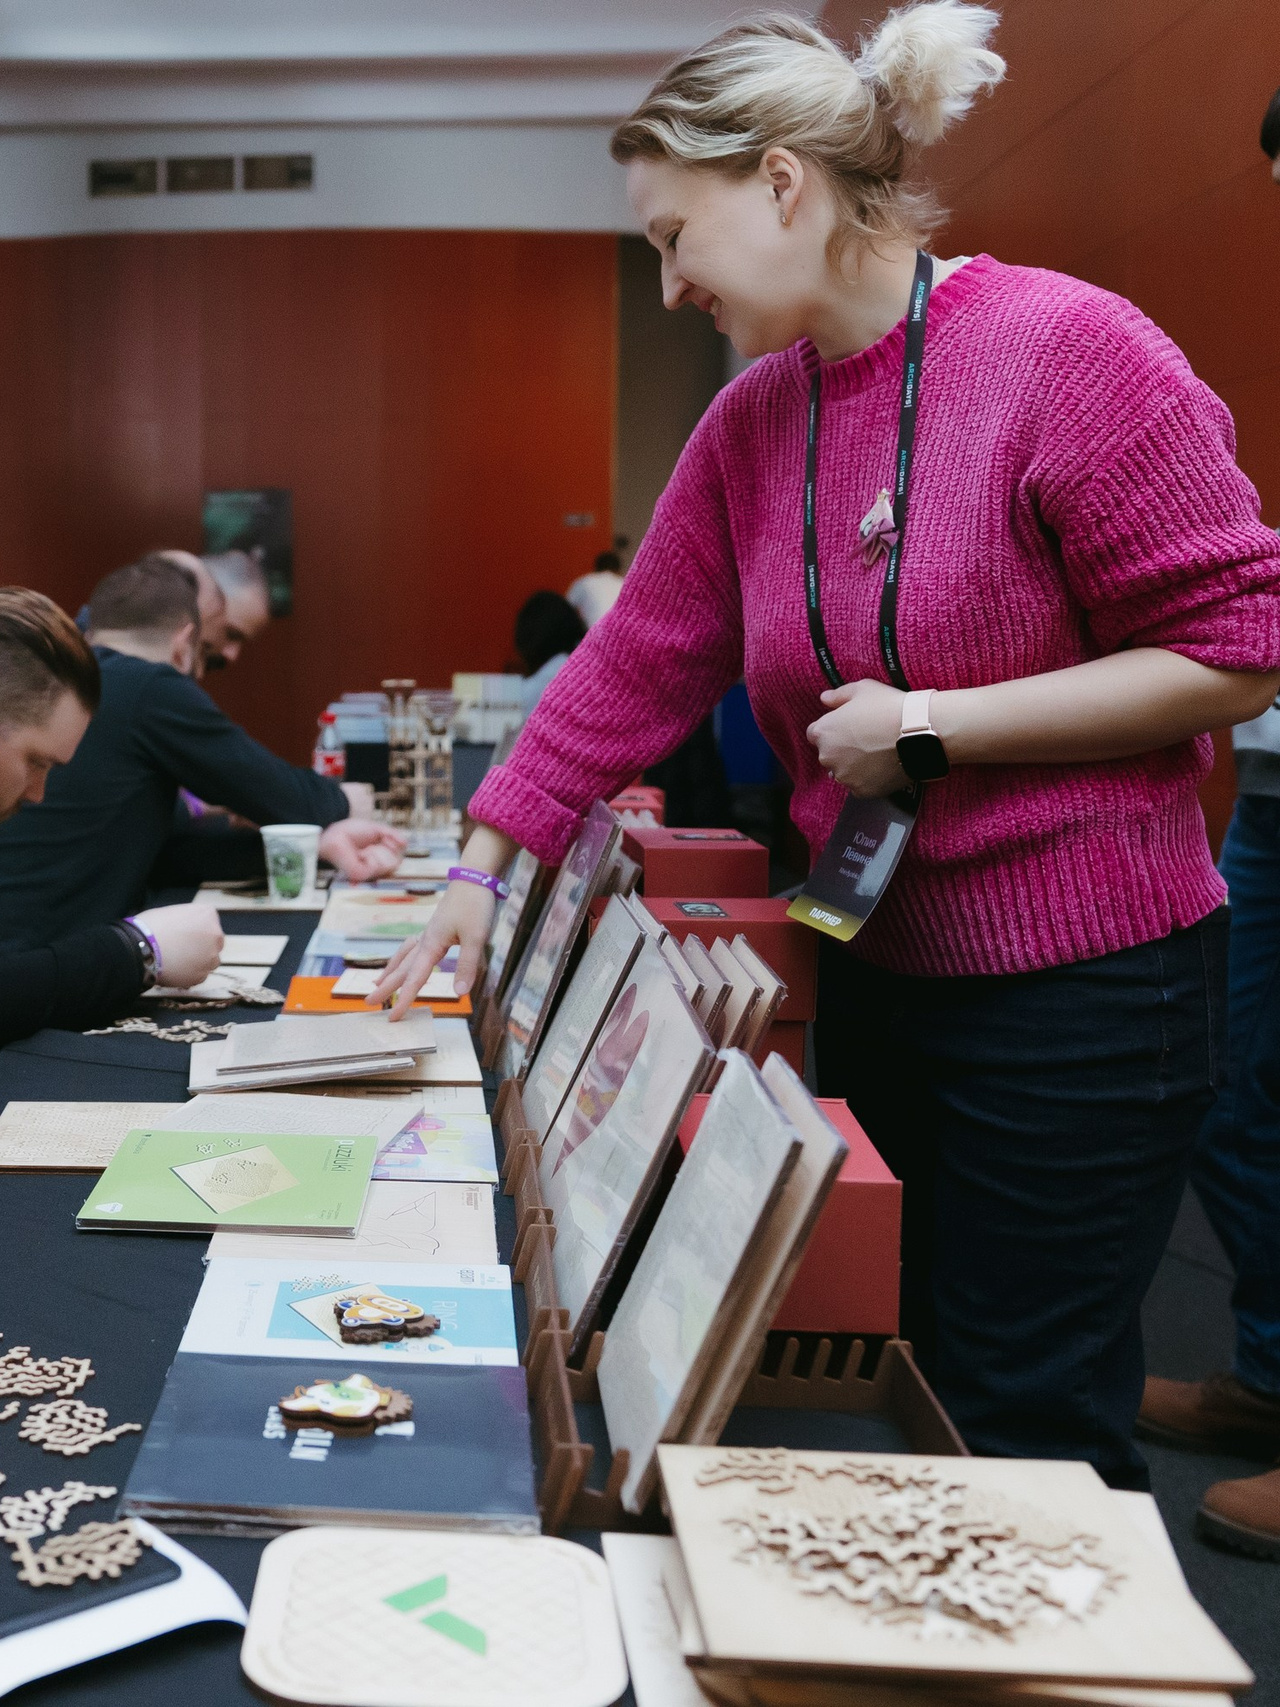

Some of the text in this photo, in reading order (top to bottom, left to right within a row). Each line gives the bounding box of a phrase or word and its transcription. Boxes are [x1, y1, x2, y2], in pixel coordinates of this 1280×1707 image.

[852, 830, 877, 849] Юлия
[808, 906, 843, 927] ПАРТНЕР
[331, 1140, 355, 1171] puzzluki
